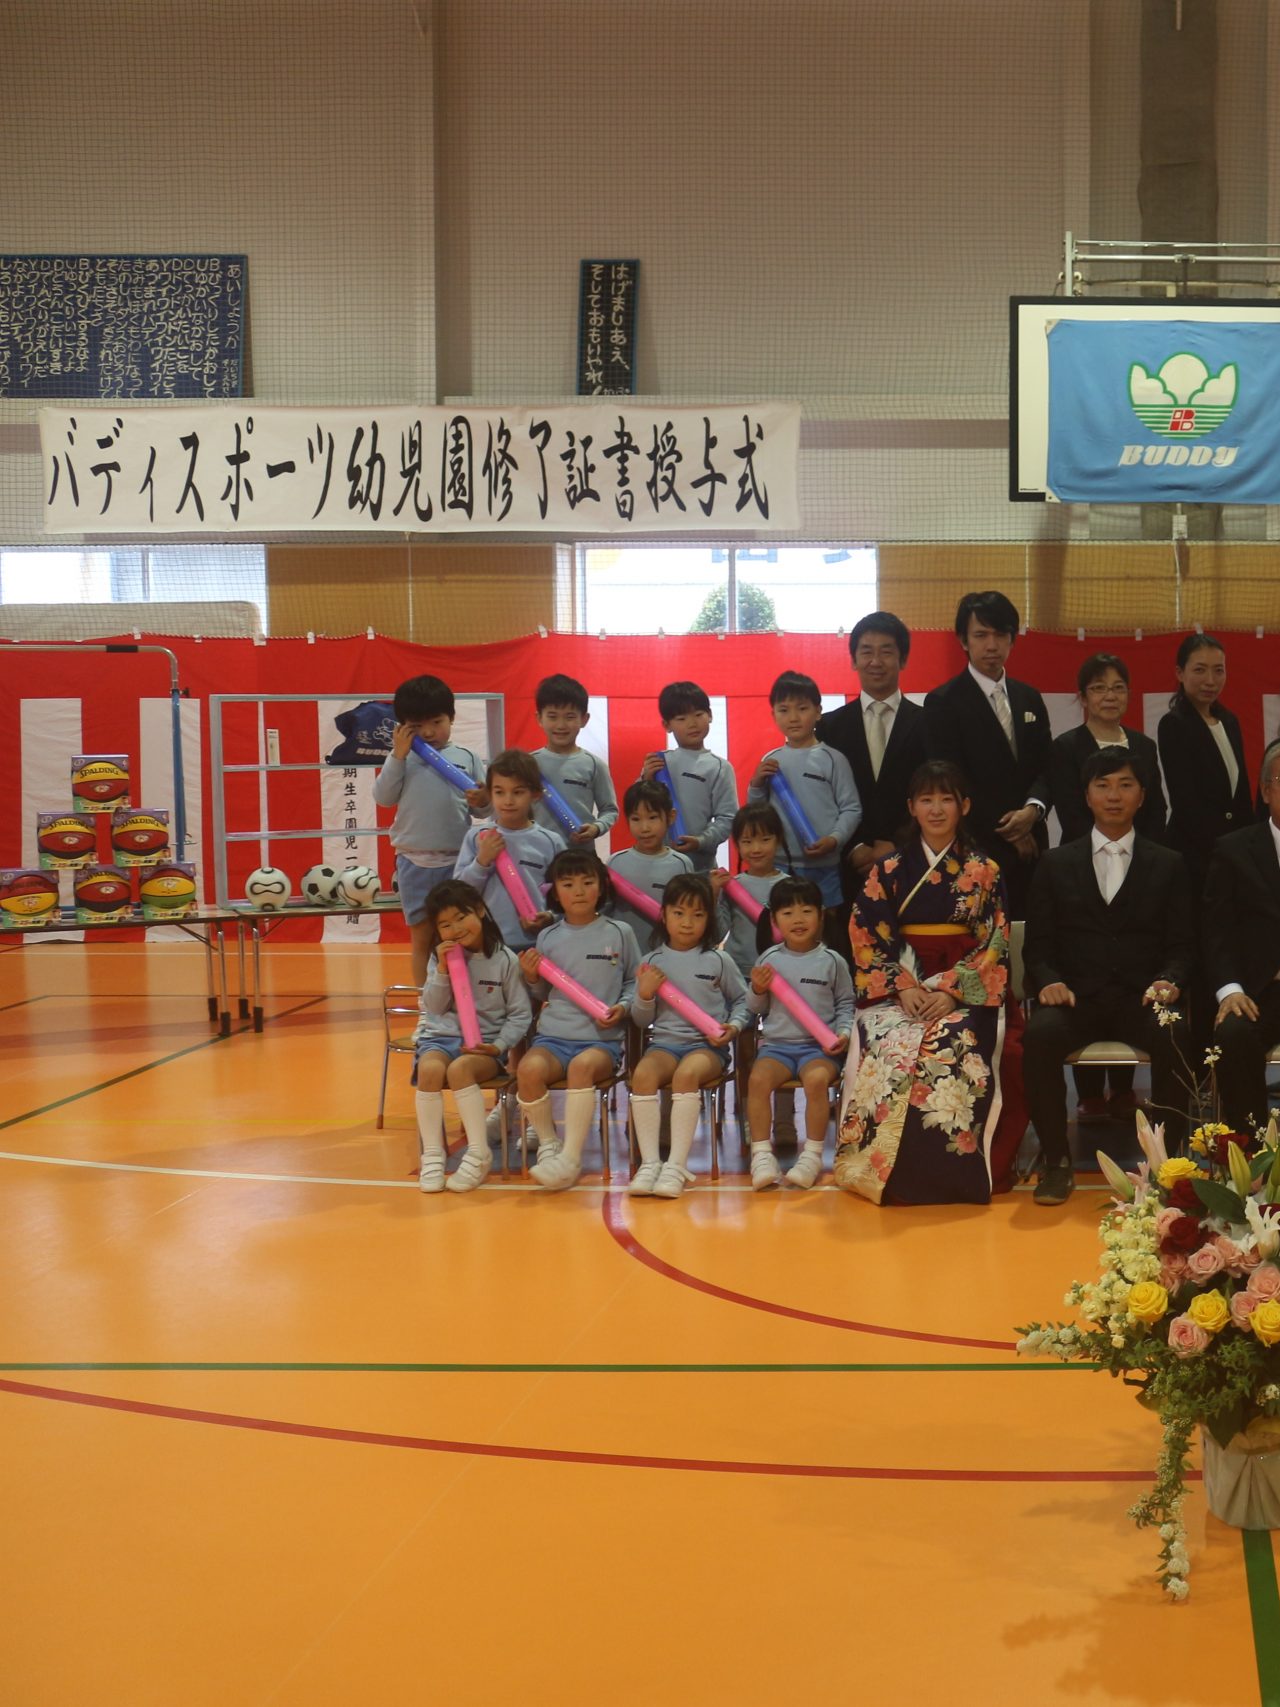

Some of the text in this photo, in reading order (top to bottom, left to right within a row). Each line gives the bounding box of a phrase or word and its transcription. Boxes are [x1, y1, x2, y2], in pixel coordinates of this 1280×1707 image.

[48, 414, 770, 523] バディスポーツ幼児園修了証書授与式
[79, 766, 119, 779] SPALDING
